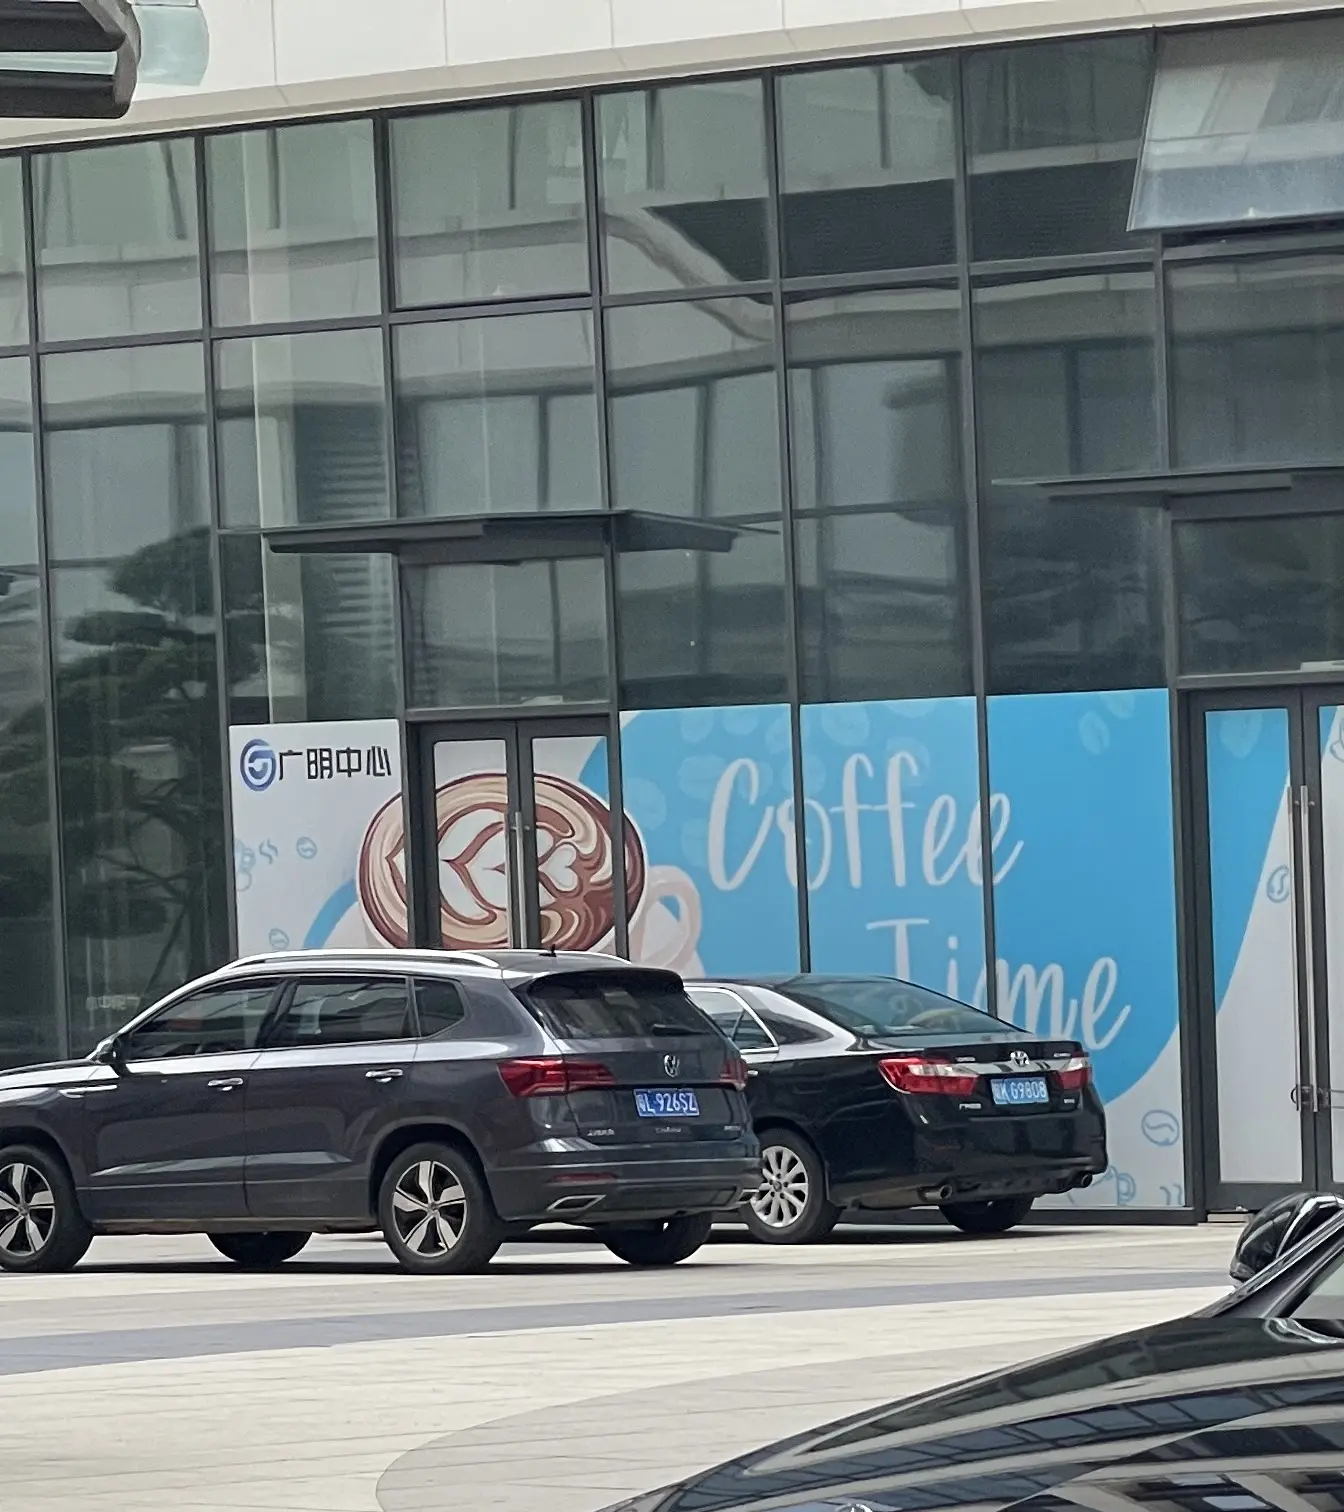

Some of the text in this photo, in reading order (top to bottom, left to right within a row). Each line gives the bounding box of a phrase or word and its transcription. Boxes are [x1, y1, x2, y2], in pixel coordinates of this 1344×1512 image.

[278, 745, 391, 780] 广明中心
[708, 751, 1024, 891] Coffee
